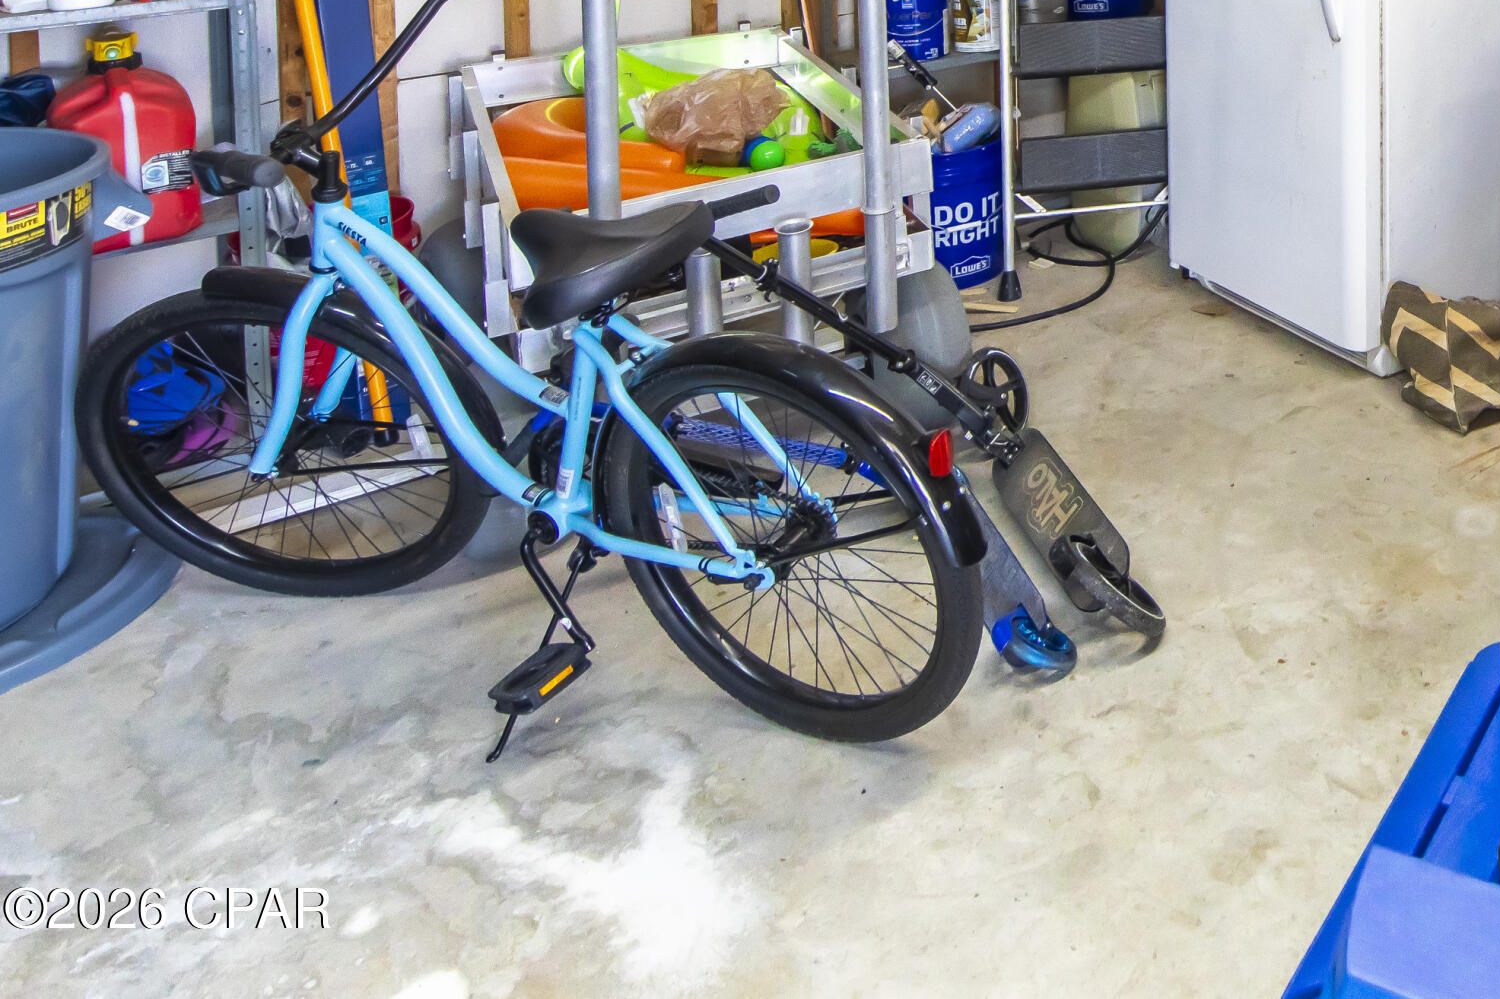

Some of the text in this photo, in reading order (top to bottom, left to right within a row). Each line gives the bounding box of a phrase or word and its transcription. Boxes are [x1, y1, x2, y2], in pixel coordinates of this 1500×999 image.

[934, 191, 999, 226] DO IT
[6, 217, 39, 233] BRUTE
[935, 215, 999, 248] RIGHT
[955, 259, 988, 275] LOWE'S
